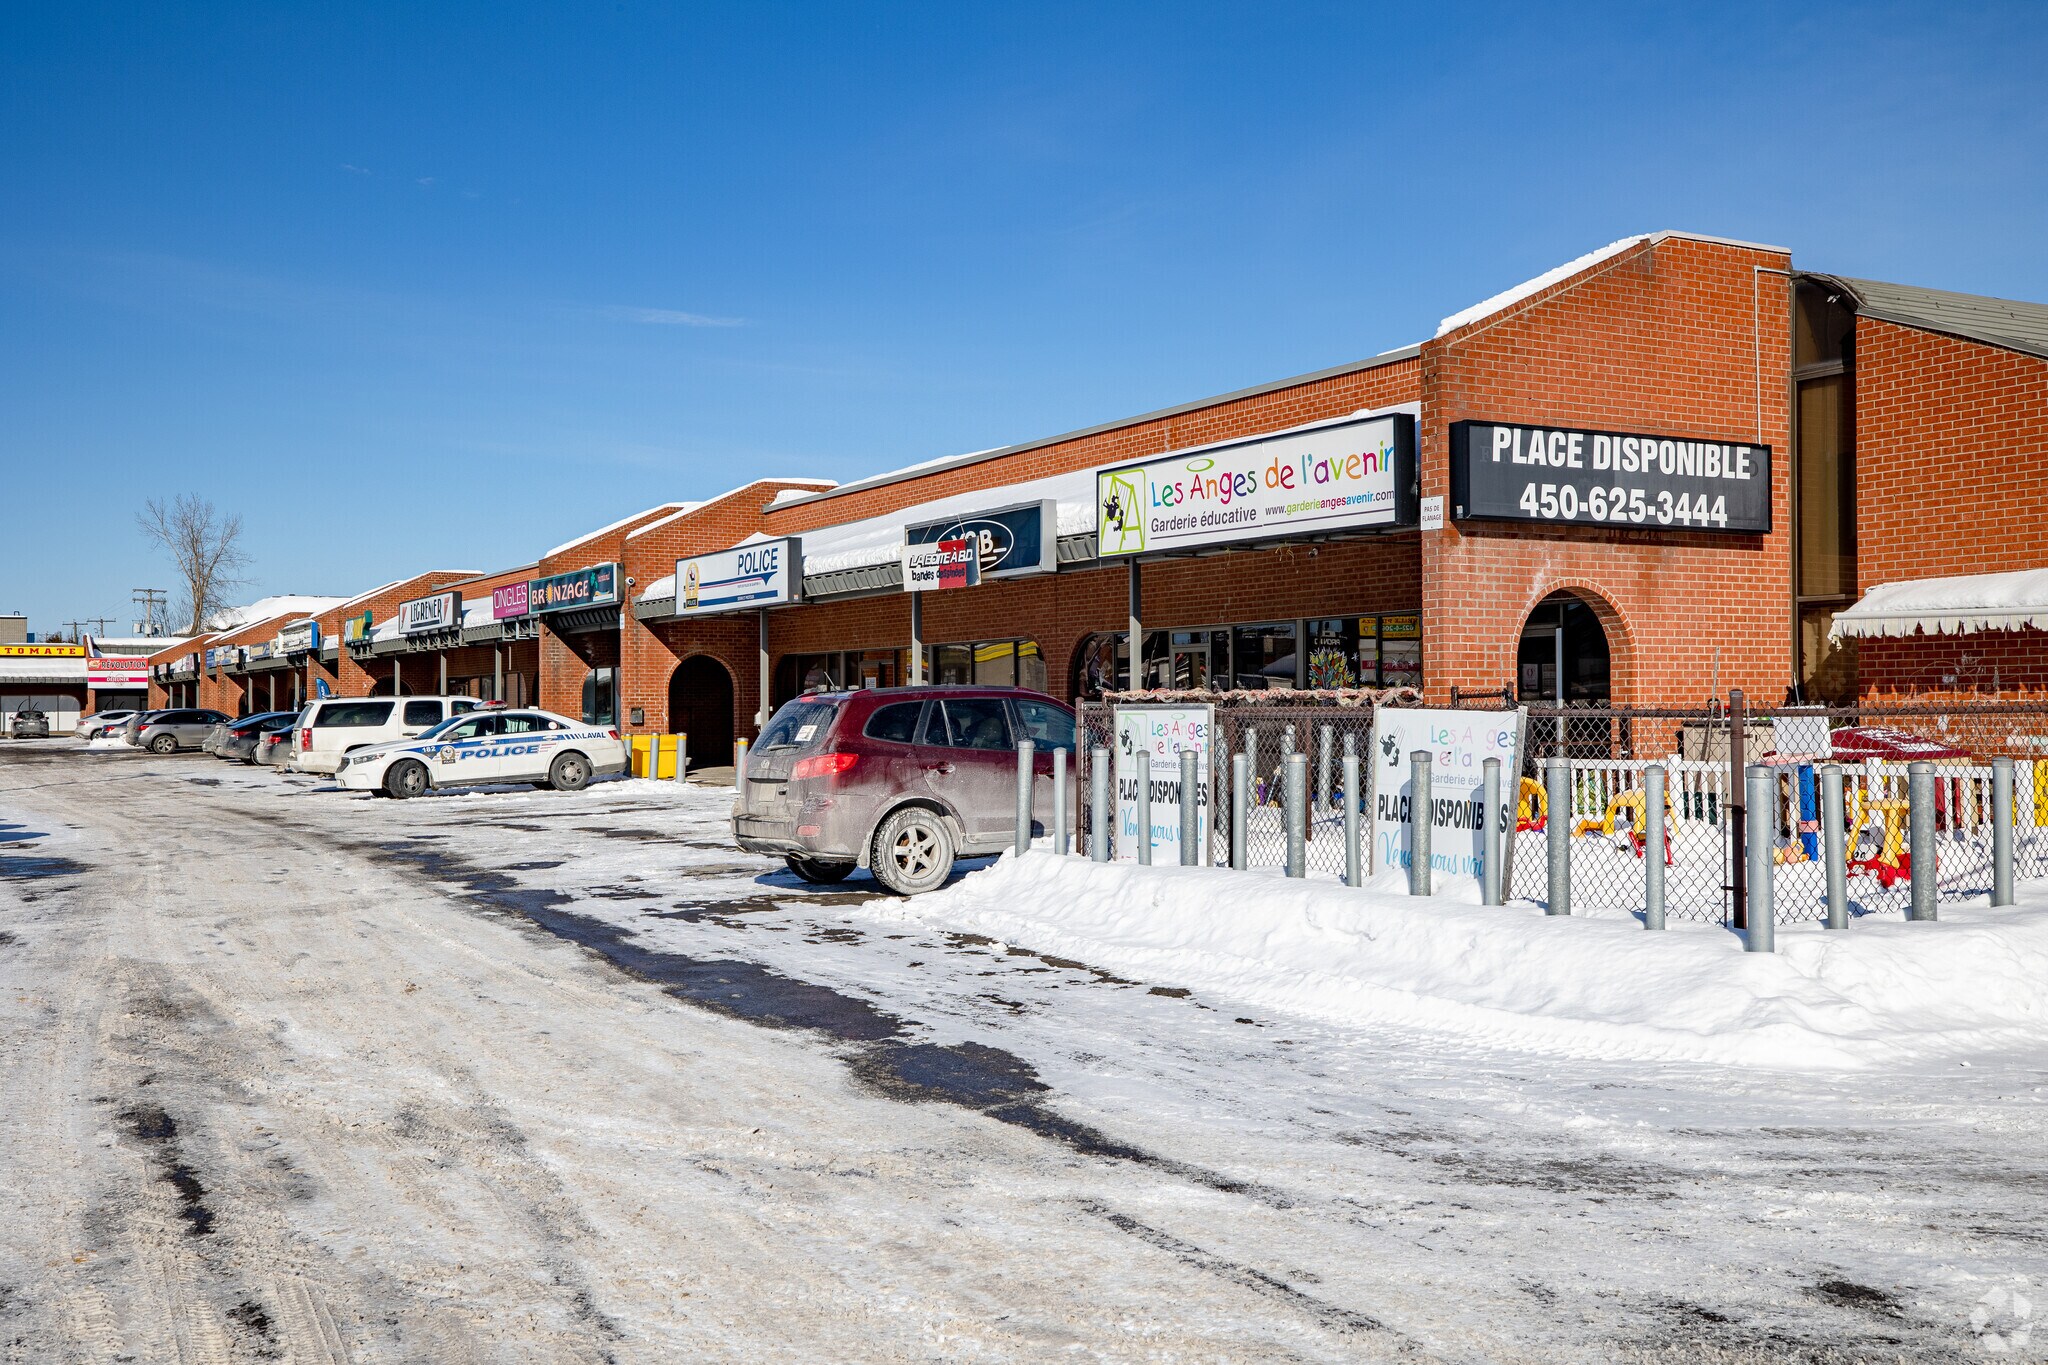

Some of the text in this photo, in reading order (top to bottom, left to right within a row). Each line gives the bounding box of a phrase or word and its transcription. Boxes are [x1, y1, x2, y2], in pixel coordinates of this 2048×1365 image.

[1492, 426, 1583, 469] PLACE
[1593, 435, 1751, 480] DISPONIBLE
[1151, 440, 1394, 507] Les Anges de l'avenir
[1265, 489, 1395, 516] www.garderieangesavenir.com
[1433, 504, 1440, 512] DE
[1519, 482, 1728, 528] 450-625-3444
[1151, 507, 1257, 532] Garderie éducative
[737, 547, 779, 575] POLICE
[911, 568, 934, 581] bandes
[493, 584, 527, 609] ONGLES
[4, 647, 76, 655] TOMATE
[582, 731, 606, 740] LAVAL
[1151, 720, 1169, 737] Les
[1430, 724, 1457, 745] Les
[459, 744, 542, 761] POLICE
[1151, 759, 1176, 769] Garderie
[1119, 778, 1138, 802] PLAC
[1462, 849, 1485, 877] voi
